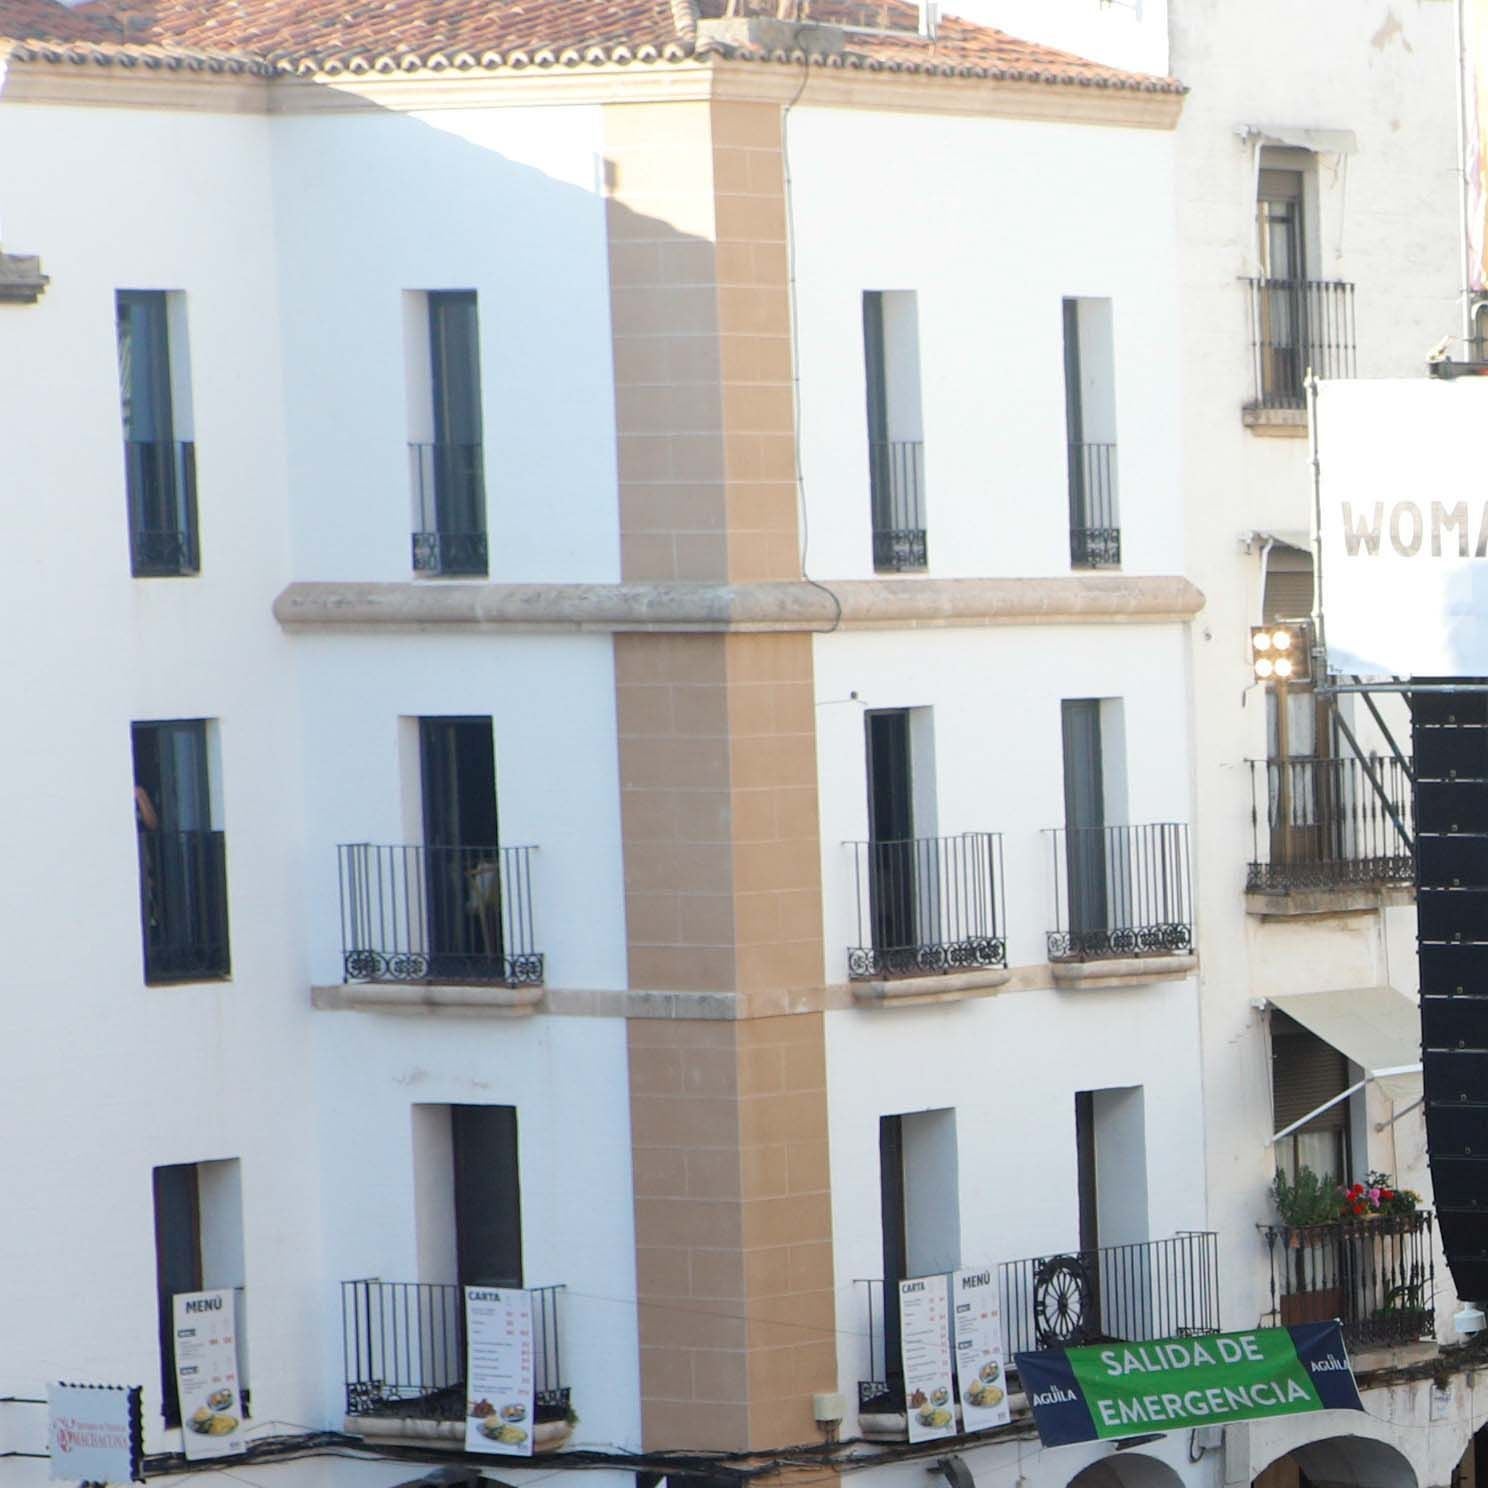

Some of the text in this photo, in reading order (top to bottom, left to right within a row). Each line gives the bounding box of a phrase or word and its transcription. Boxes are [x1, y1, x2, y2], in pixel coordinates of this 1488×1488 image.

[1101, 1335, 1264, 1377] SALIDA DE
[1097, 1379, 1310, 1426] EMERGENCIA
